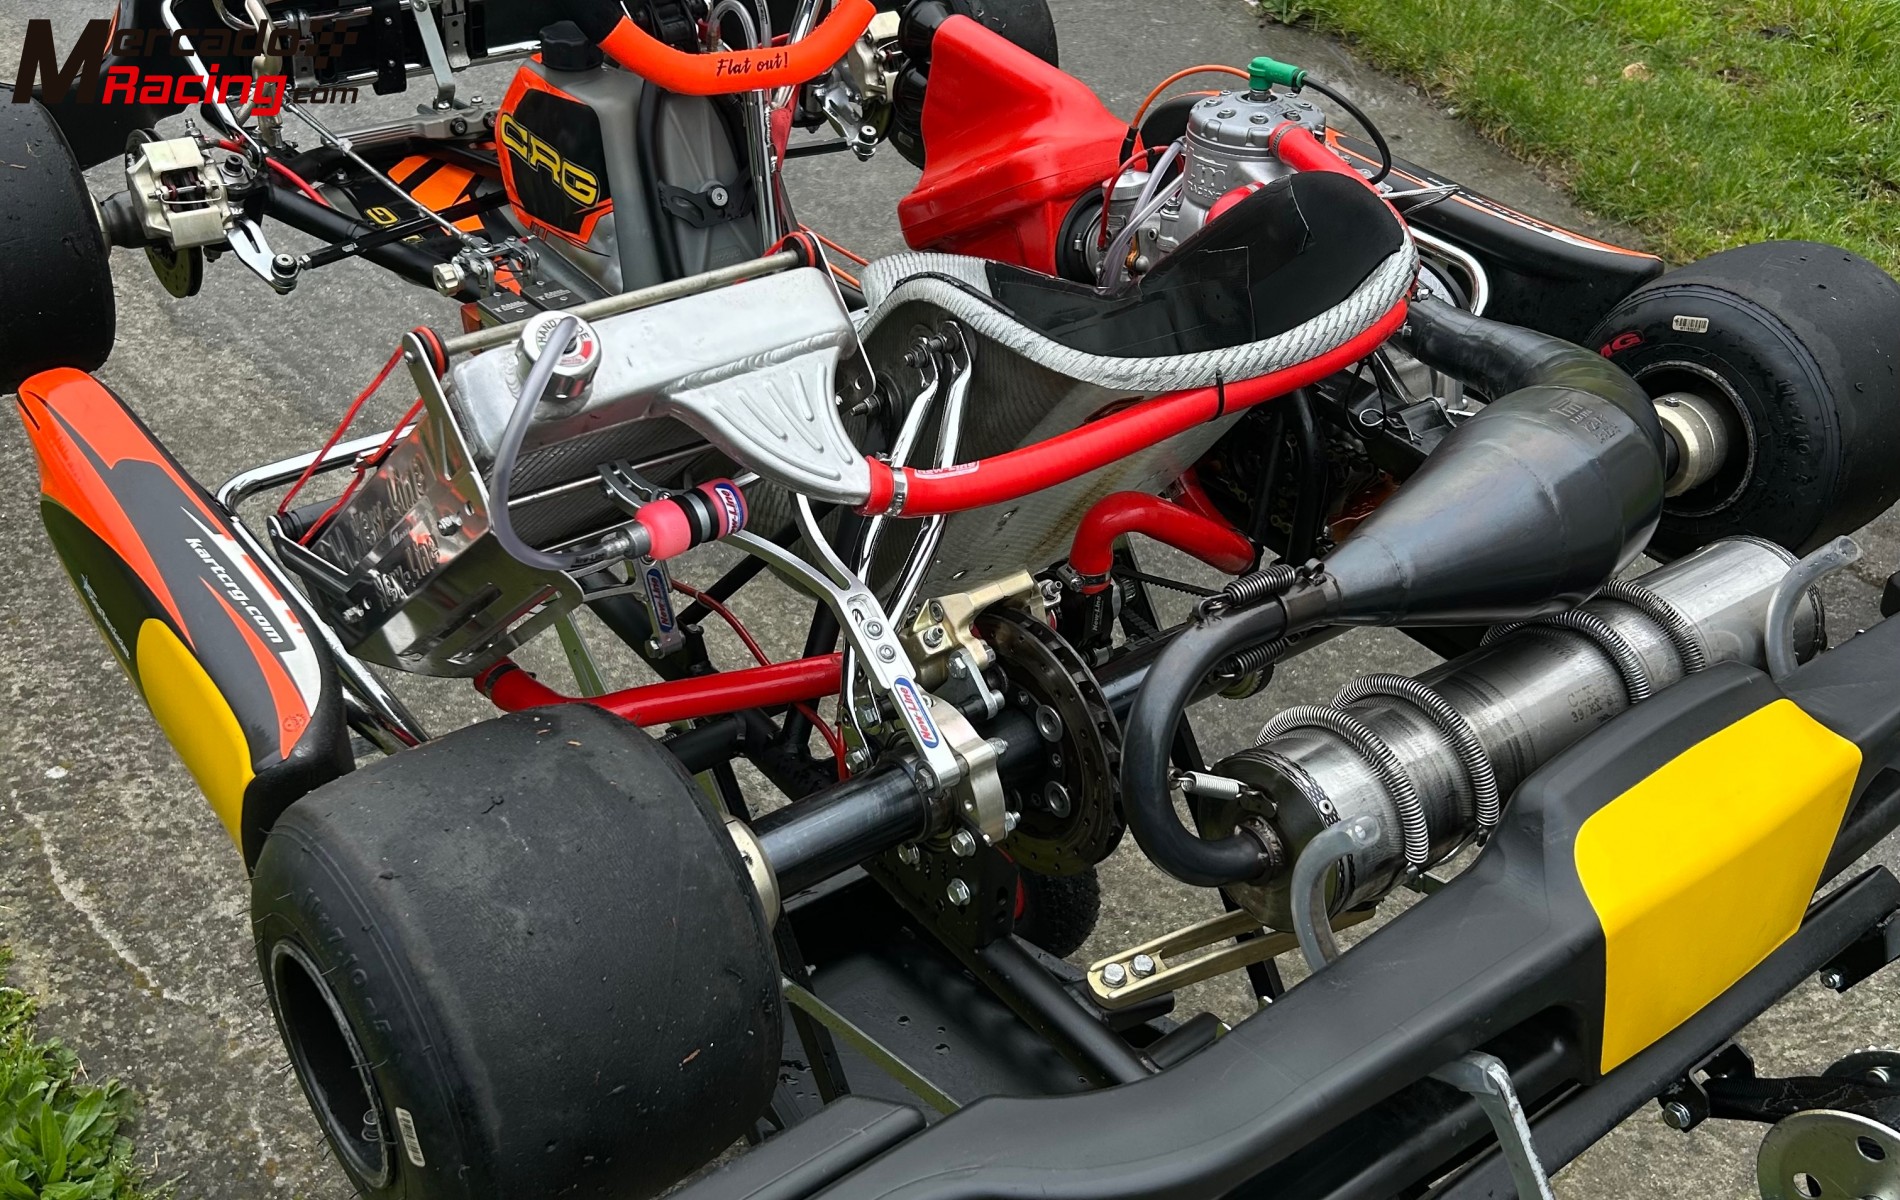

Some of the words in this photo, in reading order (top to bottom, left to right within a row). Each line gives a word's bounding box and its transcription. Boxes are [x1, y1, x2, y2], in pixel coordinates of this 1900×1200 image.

[716, 57, 752, 77] Flat
[756, 51, 788, 72] out!
[500, 112, 600, 209] CRG
[538, 319, 558, 345] HAND
[185, 538, 284, 644] kartcrg.com
[649, 577, 673, 627] New-Line
[1092, 595, 1102, 631] New-Line
[900, 687, 934, 740] New-Line
